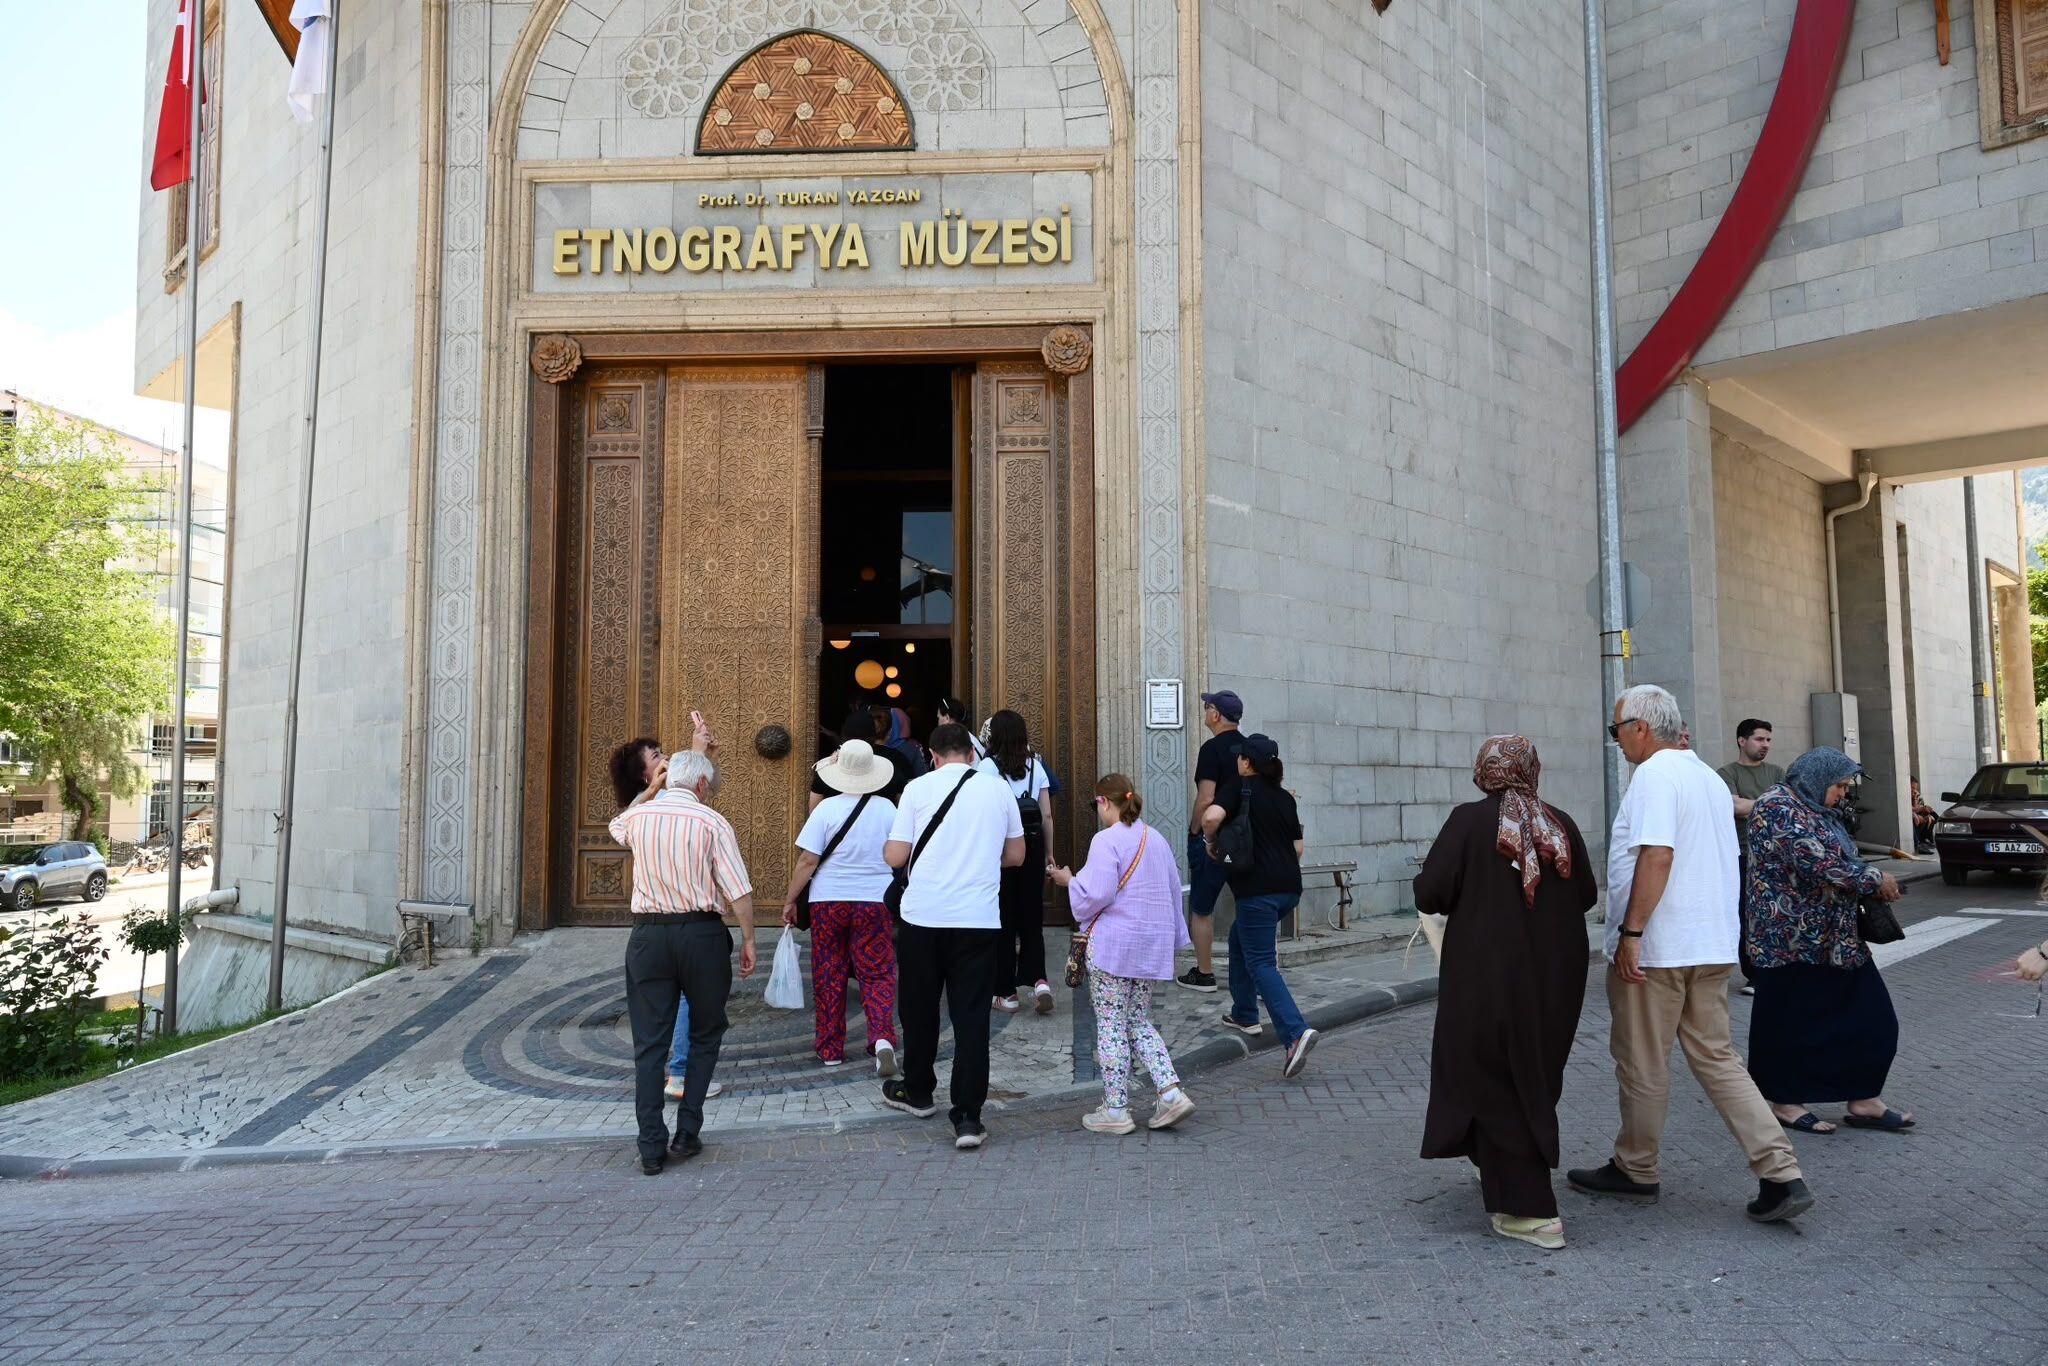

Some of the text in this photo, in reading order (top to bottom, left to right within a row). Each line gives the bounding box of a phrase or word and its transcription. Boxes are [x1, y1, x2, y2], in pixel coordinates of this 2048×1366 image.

[698, 188, 921, 207] Prof. Dr. TURAN YAZGAN
[552, 203, 1073, 274] ETNOGRAFYA MÜZESİ
[1991, 843, 2042, 853] 15 AAZ 206
